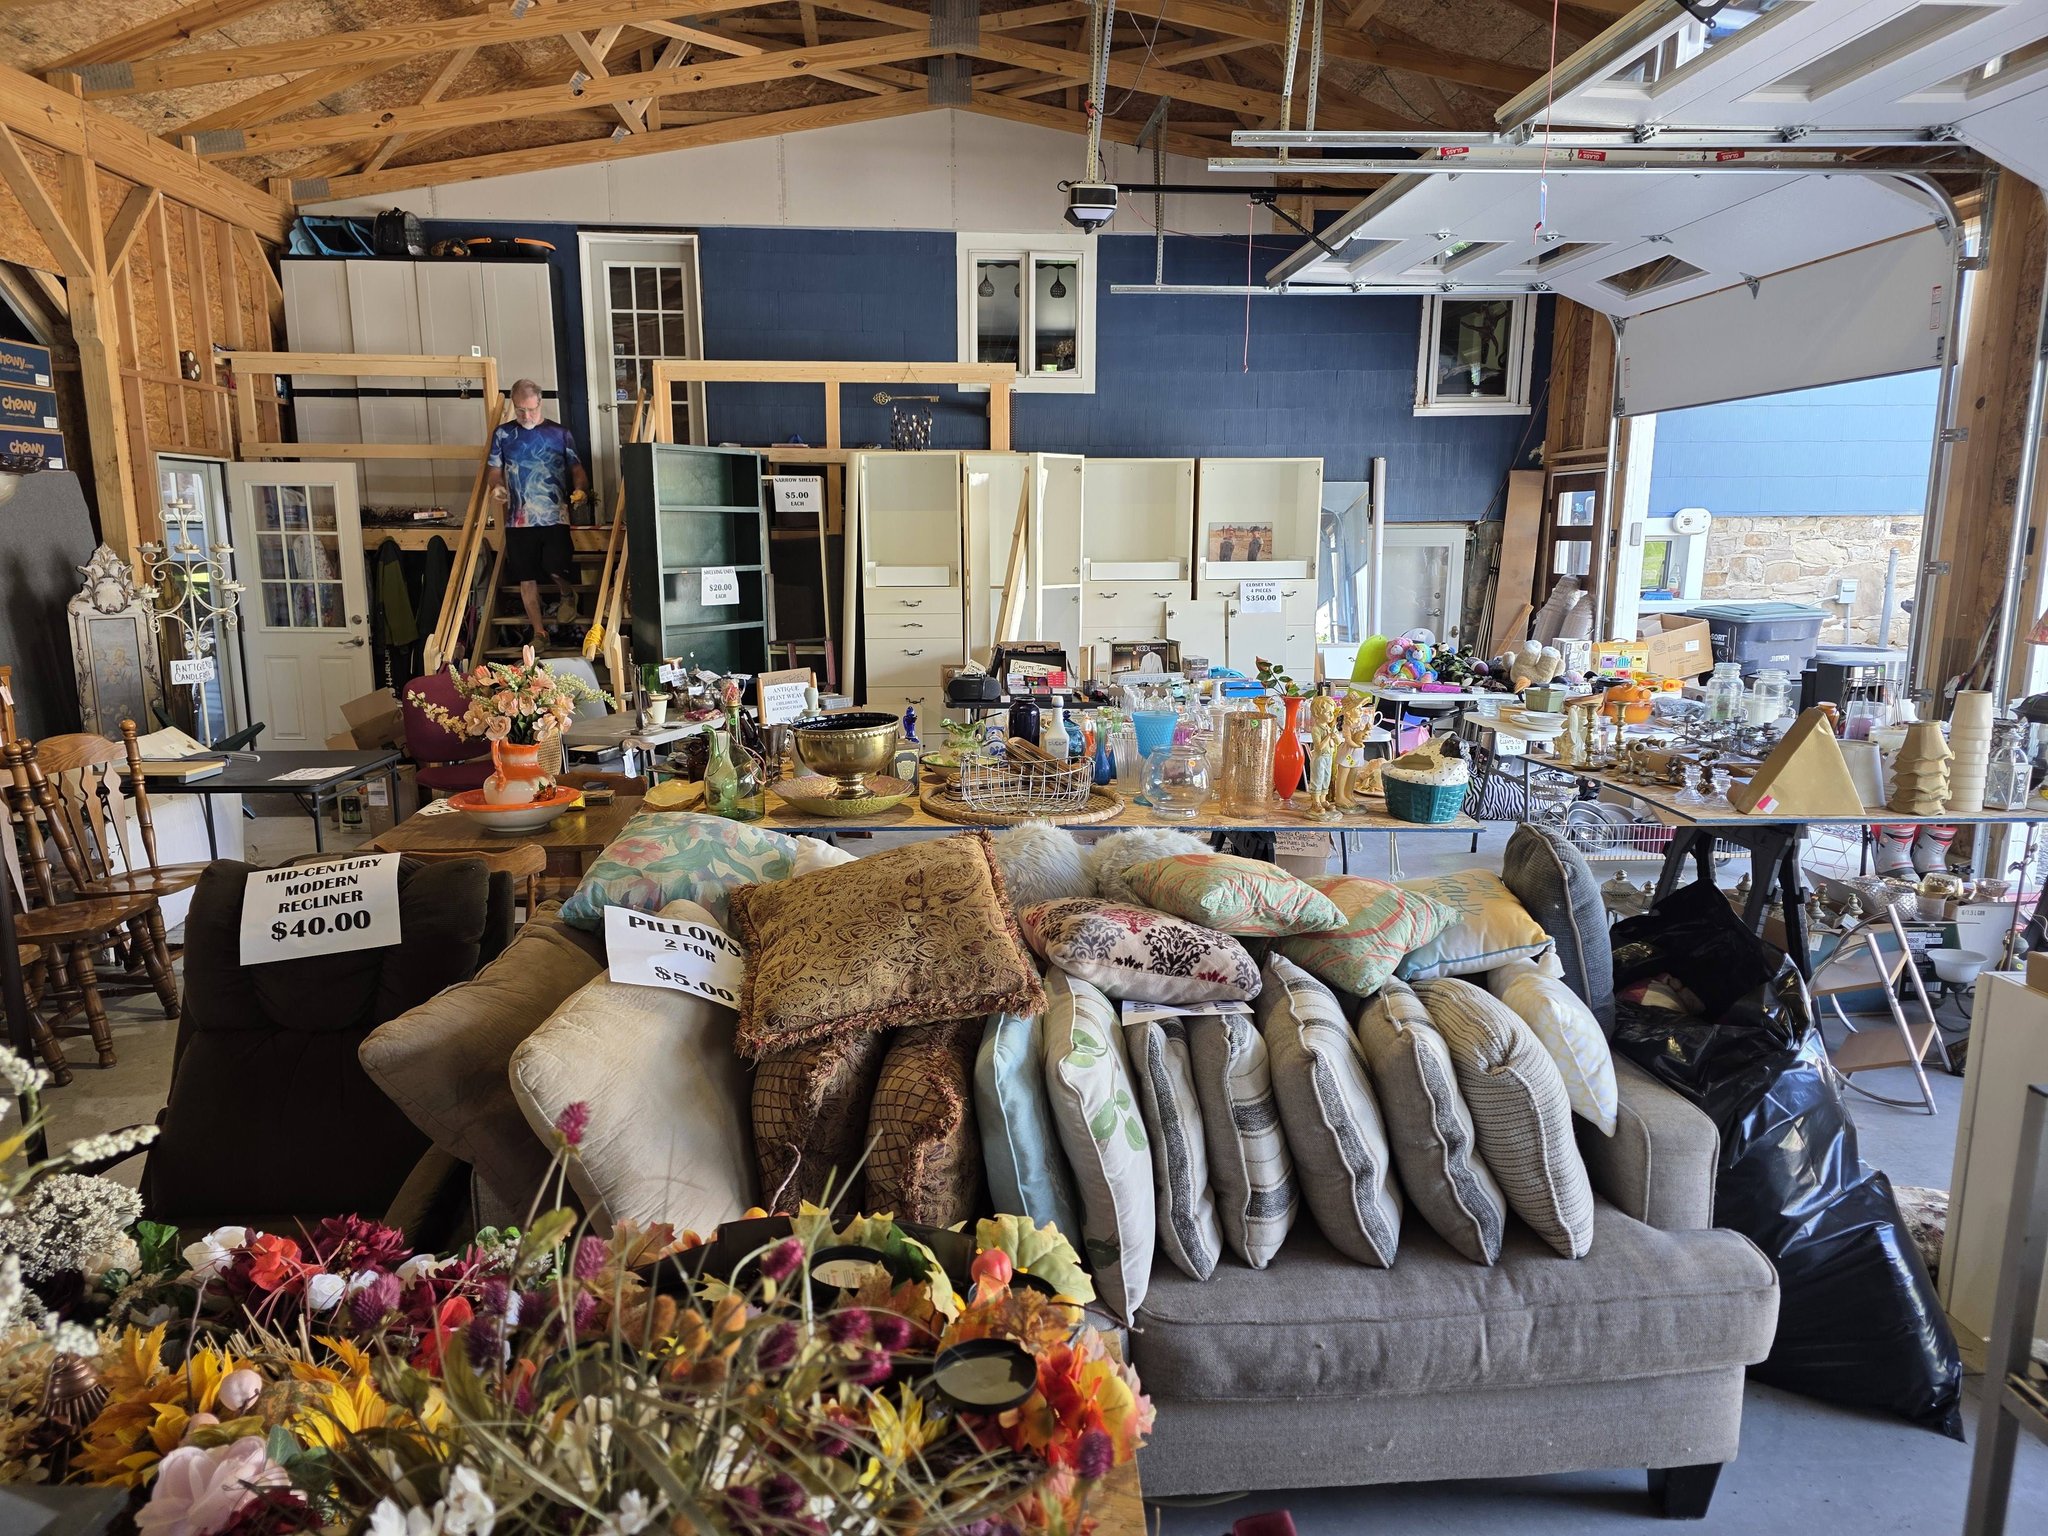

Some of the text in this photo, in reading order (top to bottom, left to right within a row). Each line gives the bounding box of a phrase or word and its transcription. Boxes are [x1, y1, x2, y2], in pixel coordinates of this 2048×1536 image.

[0, 350, 34, 370] hewy.com
[2, 395, 37, 415] chewy
[9, 439, 45, 457] chewy
[785, 491, 809, 499] $5.00
[709, 583, 733, 592] $20.00
[1245, 594, 1277, 602] $350.00
[384, 649, 393, 686] arhartt
[772, 685, 800, 694] ANTIQUE
[265, 858, 382, 883] MID-CENTURY
[285, 874, 359, 897] MODERN
[278, 890, 363, 914] RECLINER
[271, 910, 371, 942] $40.00
[628, 915, 741, 957] PILLOWS
[664, 939, 716, 963] 2 FOR
[654, 966, 735, 1001] $5.00
